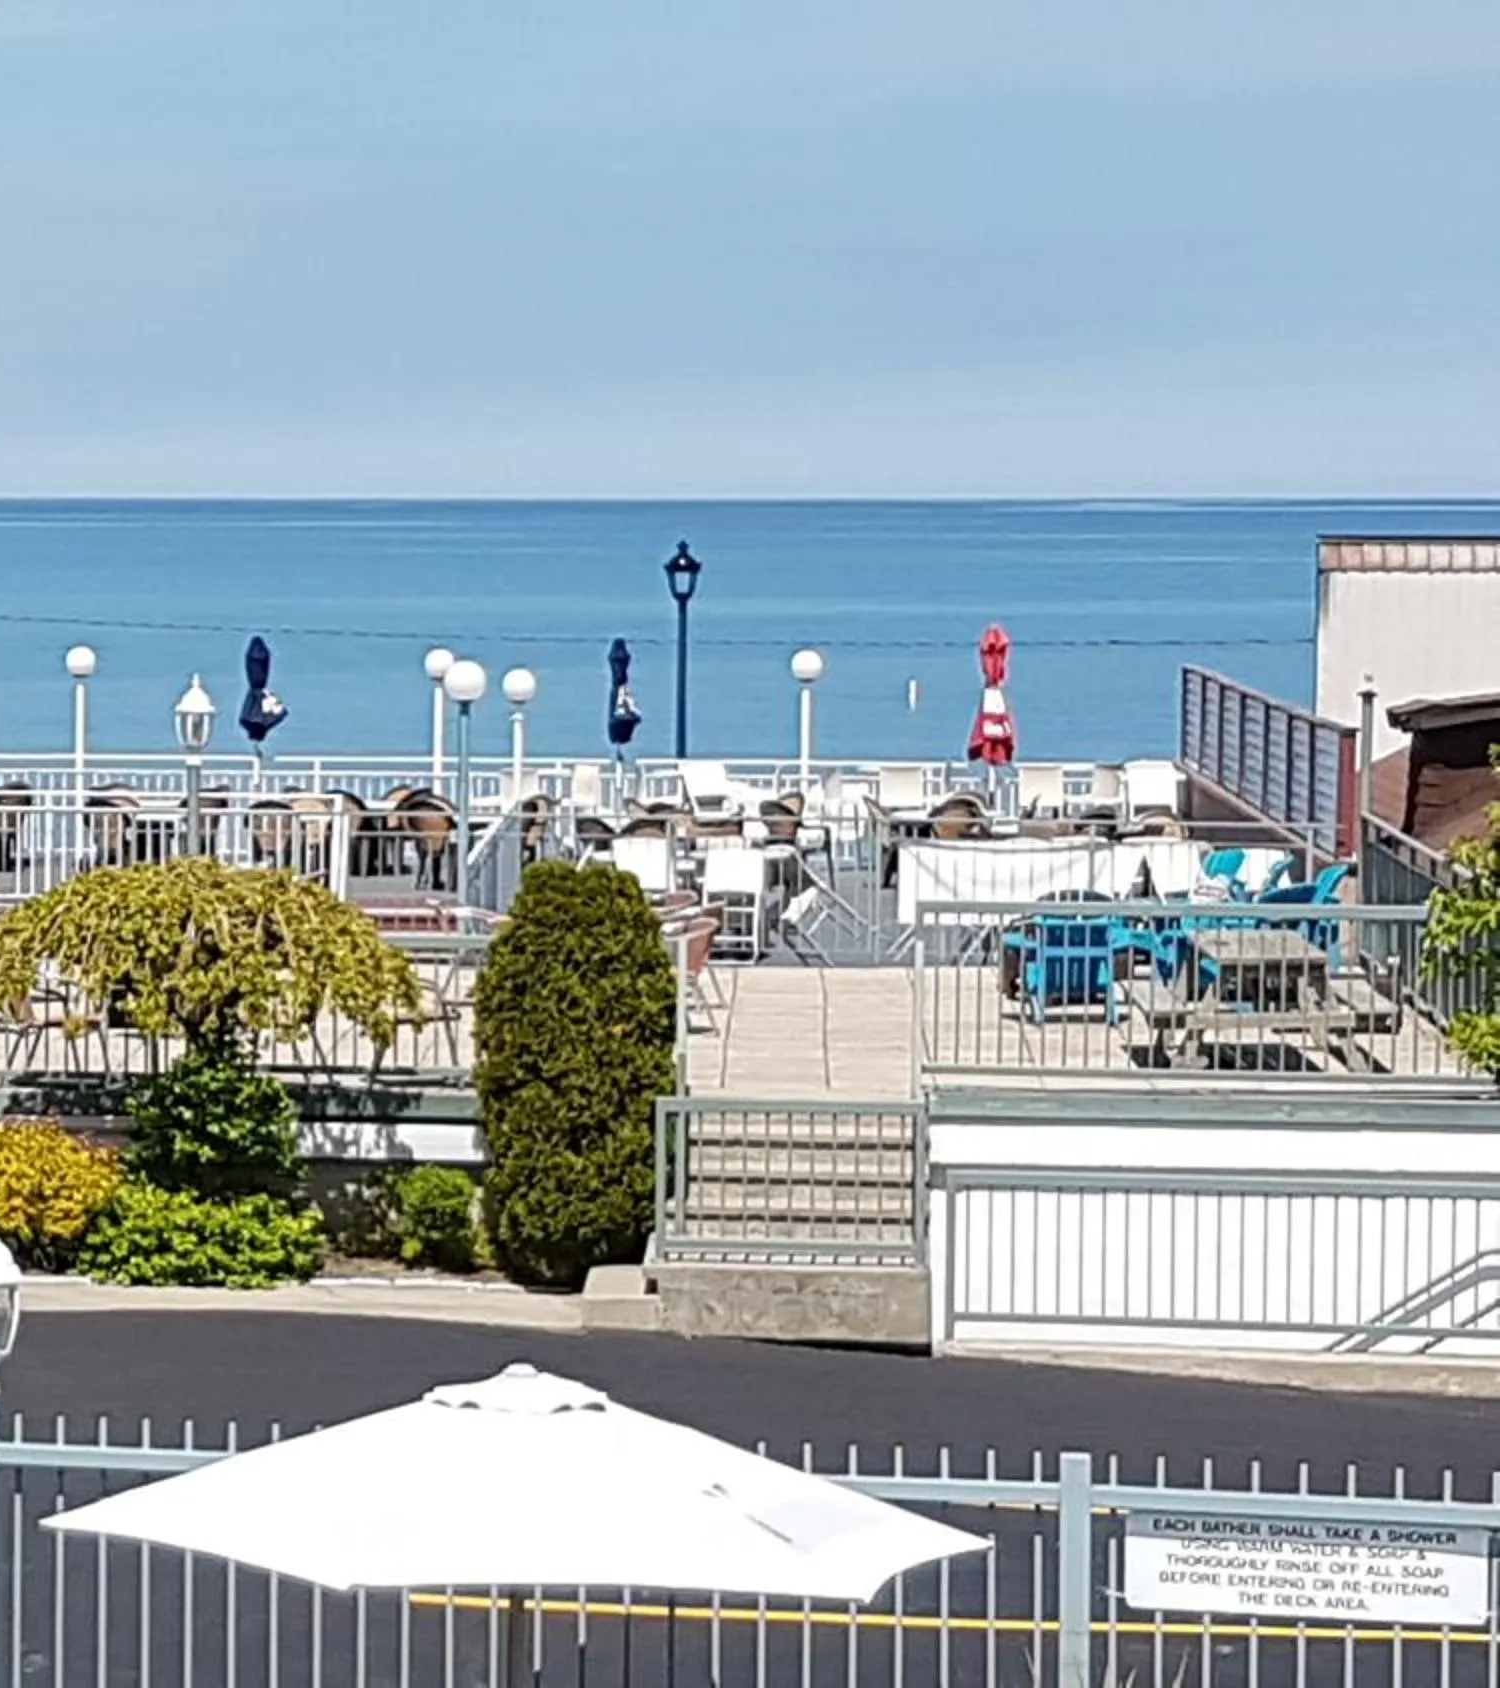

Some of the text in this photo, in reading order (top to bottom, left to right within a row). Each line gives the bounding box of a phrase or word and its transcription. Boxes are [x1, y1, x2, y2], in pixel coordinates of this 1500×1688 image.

[1153, 1518, 1457, 1545] EACH BATHER SHALL TAKE A SHOWER
[1291, 1541, 1341, 1557] WATER
[1166, 1553, 1269, 1571] THOROUGHLY
[1275, 1559, 1322, 1574] RINSE
[1329, 1562, 1360, 1576] OFF
[1365, 1564, 1394, 1577] ALL
[1159, 1571, 1450, 1598] BEFORE ENTERING OR RE-ENTERING
[1238, 1592, 1268, 1605] THE
[1274, 1593, 1317, 1607] DECK
